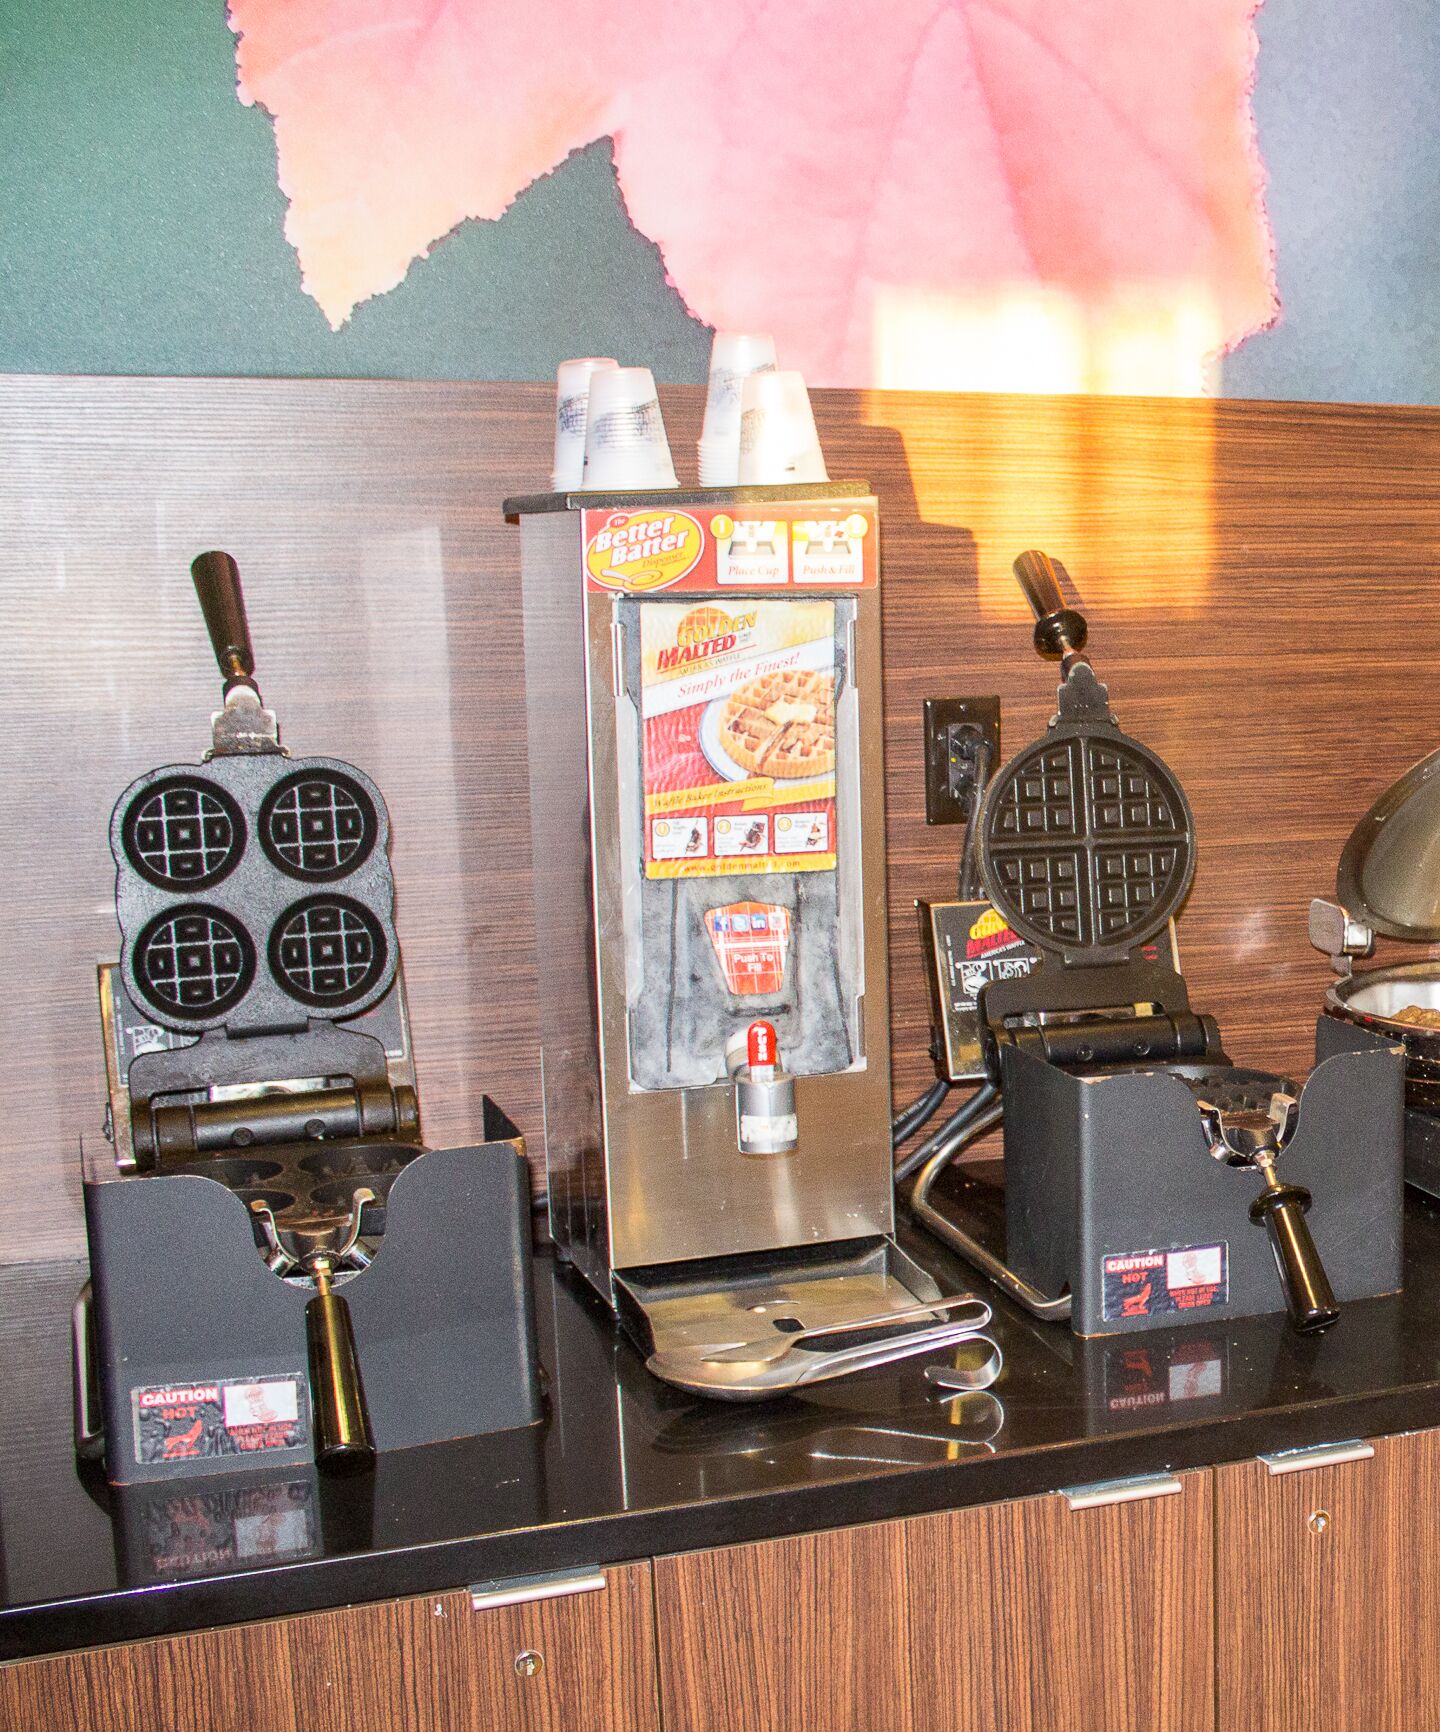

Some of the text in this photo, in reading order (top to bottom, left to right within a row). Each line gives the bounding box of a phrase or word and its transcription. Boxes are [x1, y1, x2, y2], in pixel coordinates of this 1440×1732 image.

[595, 516, 675, 553] Better
[610, 530, 689, 567] Batter
[642, 552, 685, 568] Dispenser
[728, 565, 780, 578] Place Cup
[802, 565, 828, 575] Push
[835, 564, 856, 575] Fill
[677, 611, 758, 647] GOLDEN
[657, 634, 737, 670] MALTED
[678, 651, 801, 698] Simply the Finest!
[654, 793, 684, 808] Waffle
[713, 783, 768, 799] Instructions
[683, 860, 801, 873] www.goldenmaltd.om
[733, 953, 774, 963] Push To
[747, 962, 763, 972] Fill
[755, 1026, 768, 1062] PUSH
[1107, 1255, 1164, 1271] CAUTION
[1121, 1271, 1149, 1284] HOT
[142, 1388, 218, 1406] CAUTION
[161, 1406, 198, 1420] HOT
